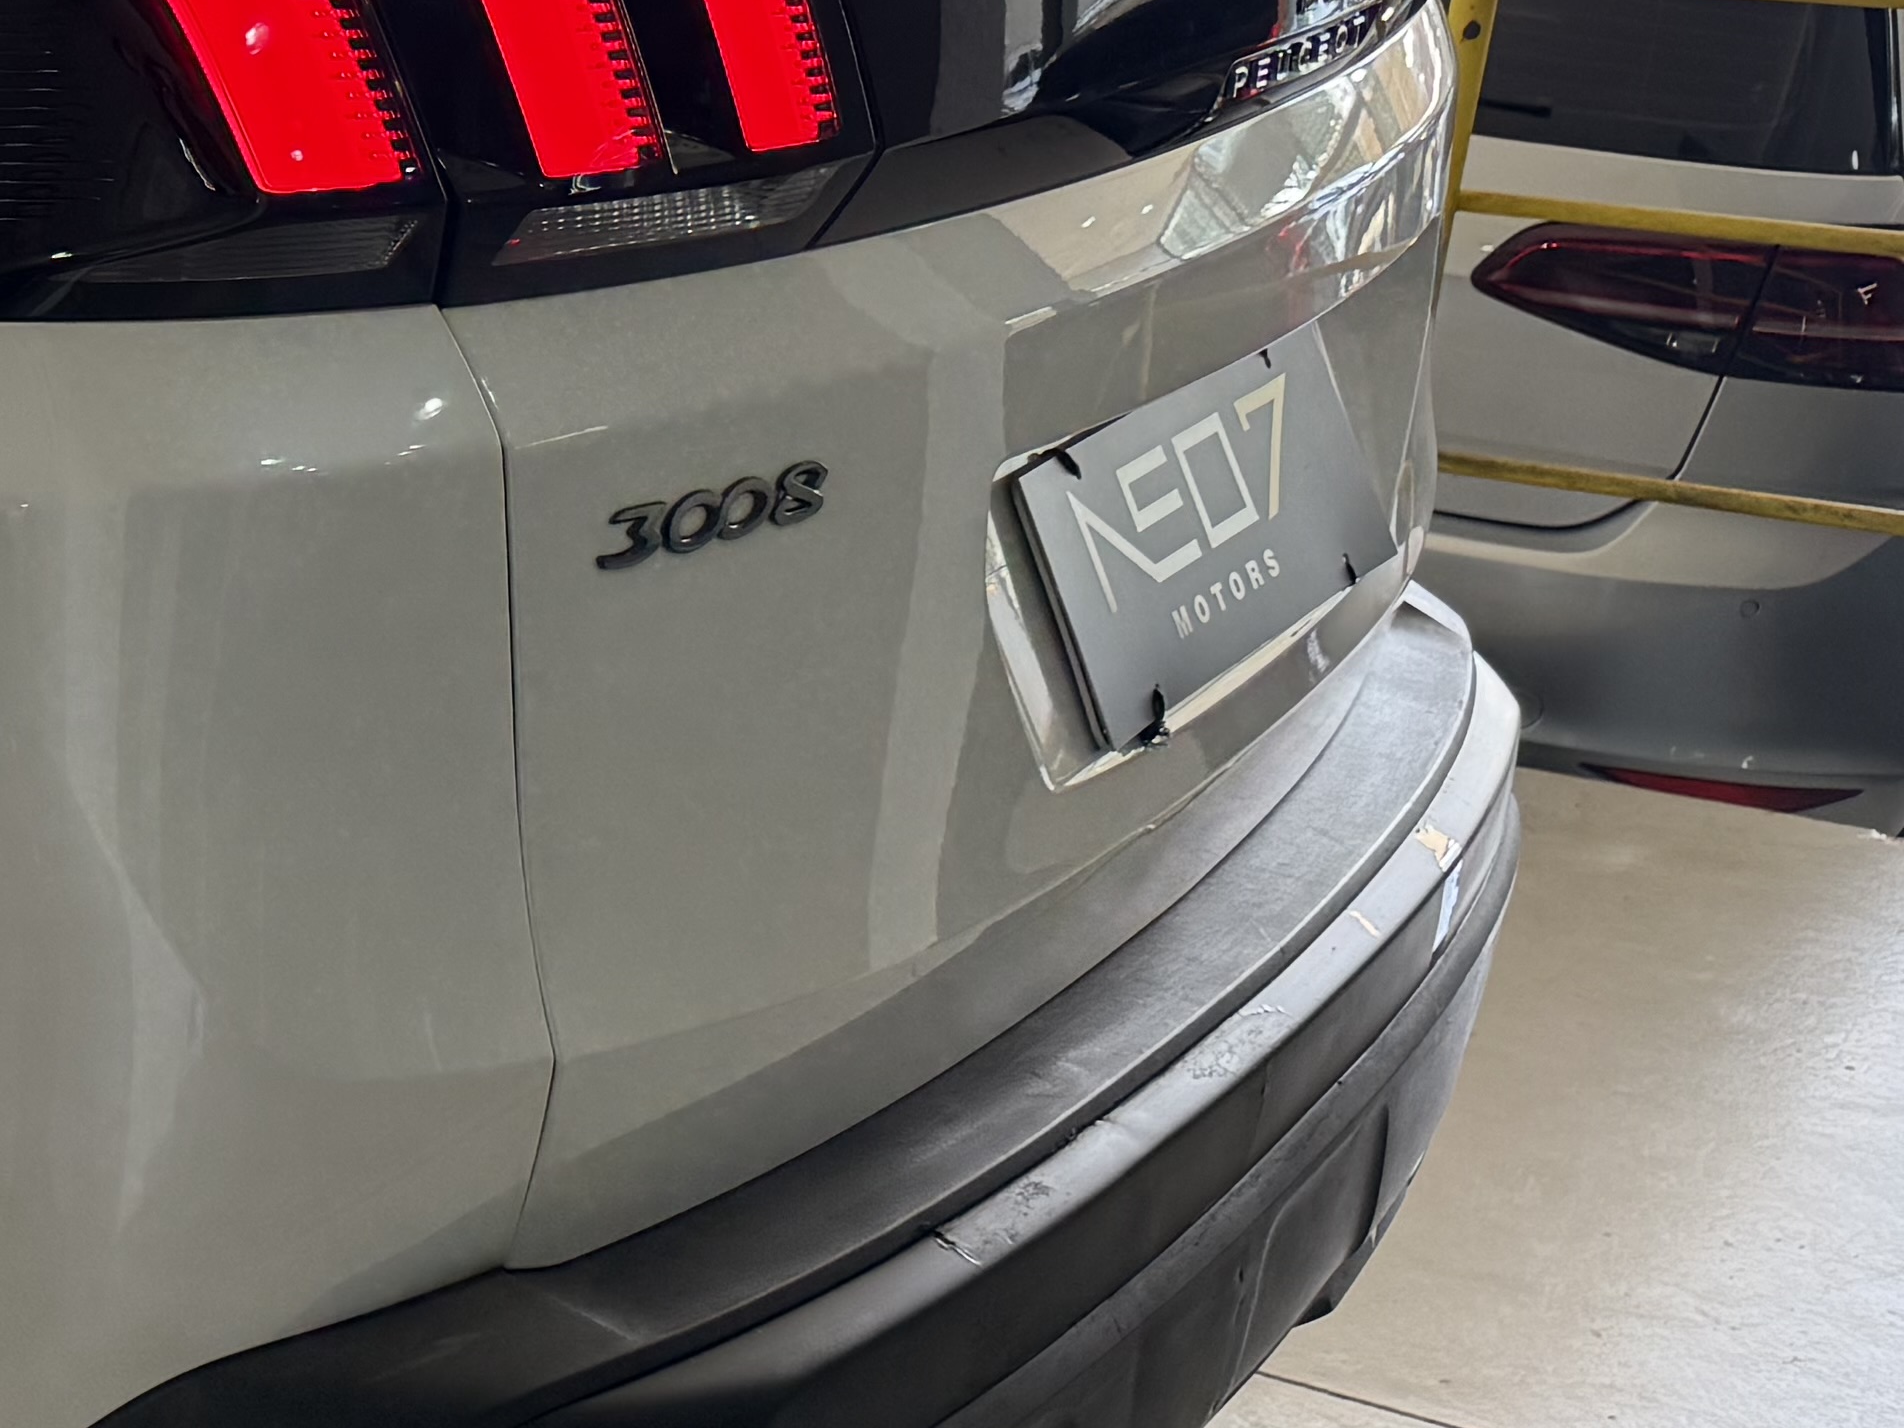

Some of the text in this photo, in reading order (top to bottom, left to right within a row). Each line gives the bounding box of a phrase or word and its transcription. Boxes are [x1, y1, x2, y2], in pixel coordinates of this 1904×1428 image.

[1232, 10, 1367, 98] PEUGEOT
[594, 458, 831, 572] 3008
[1064, 371, 1289, 614] NEO7
[1171, 546, 1282, 640] MOTORS
